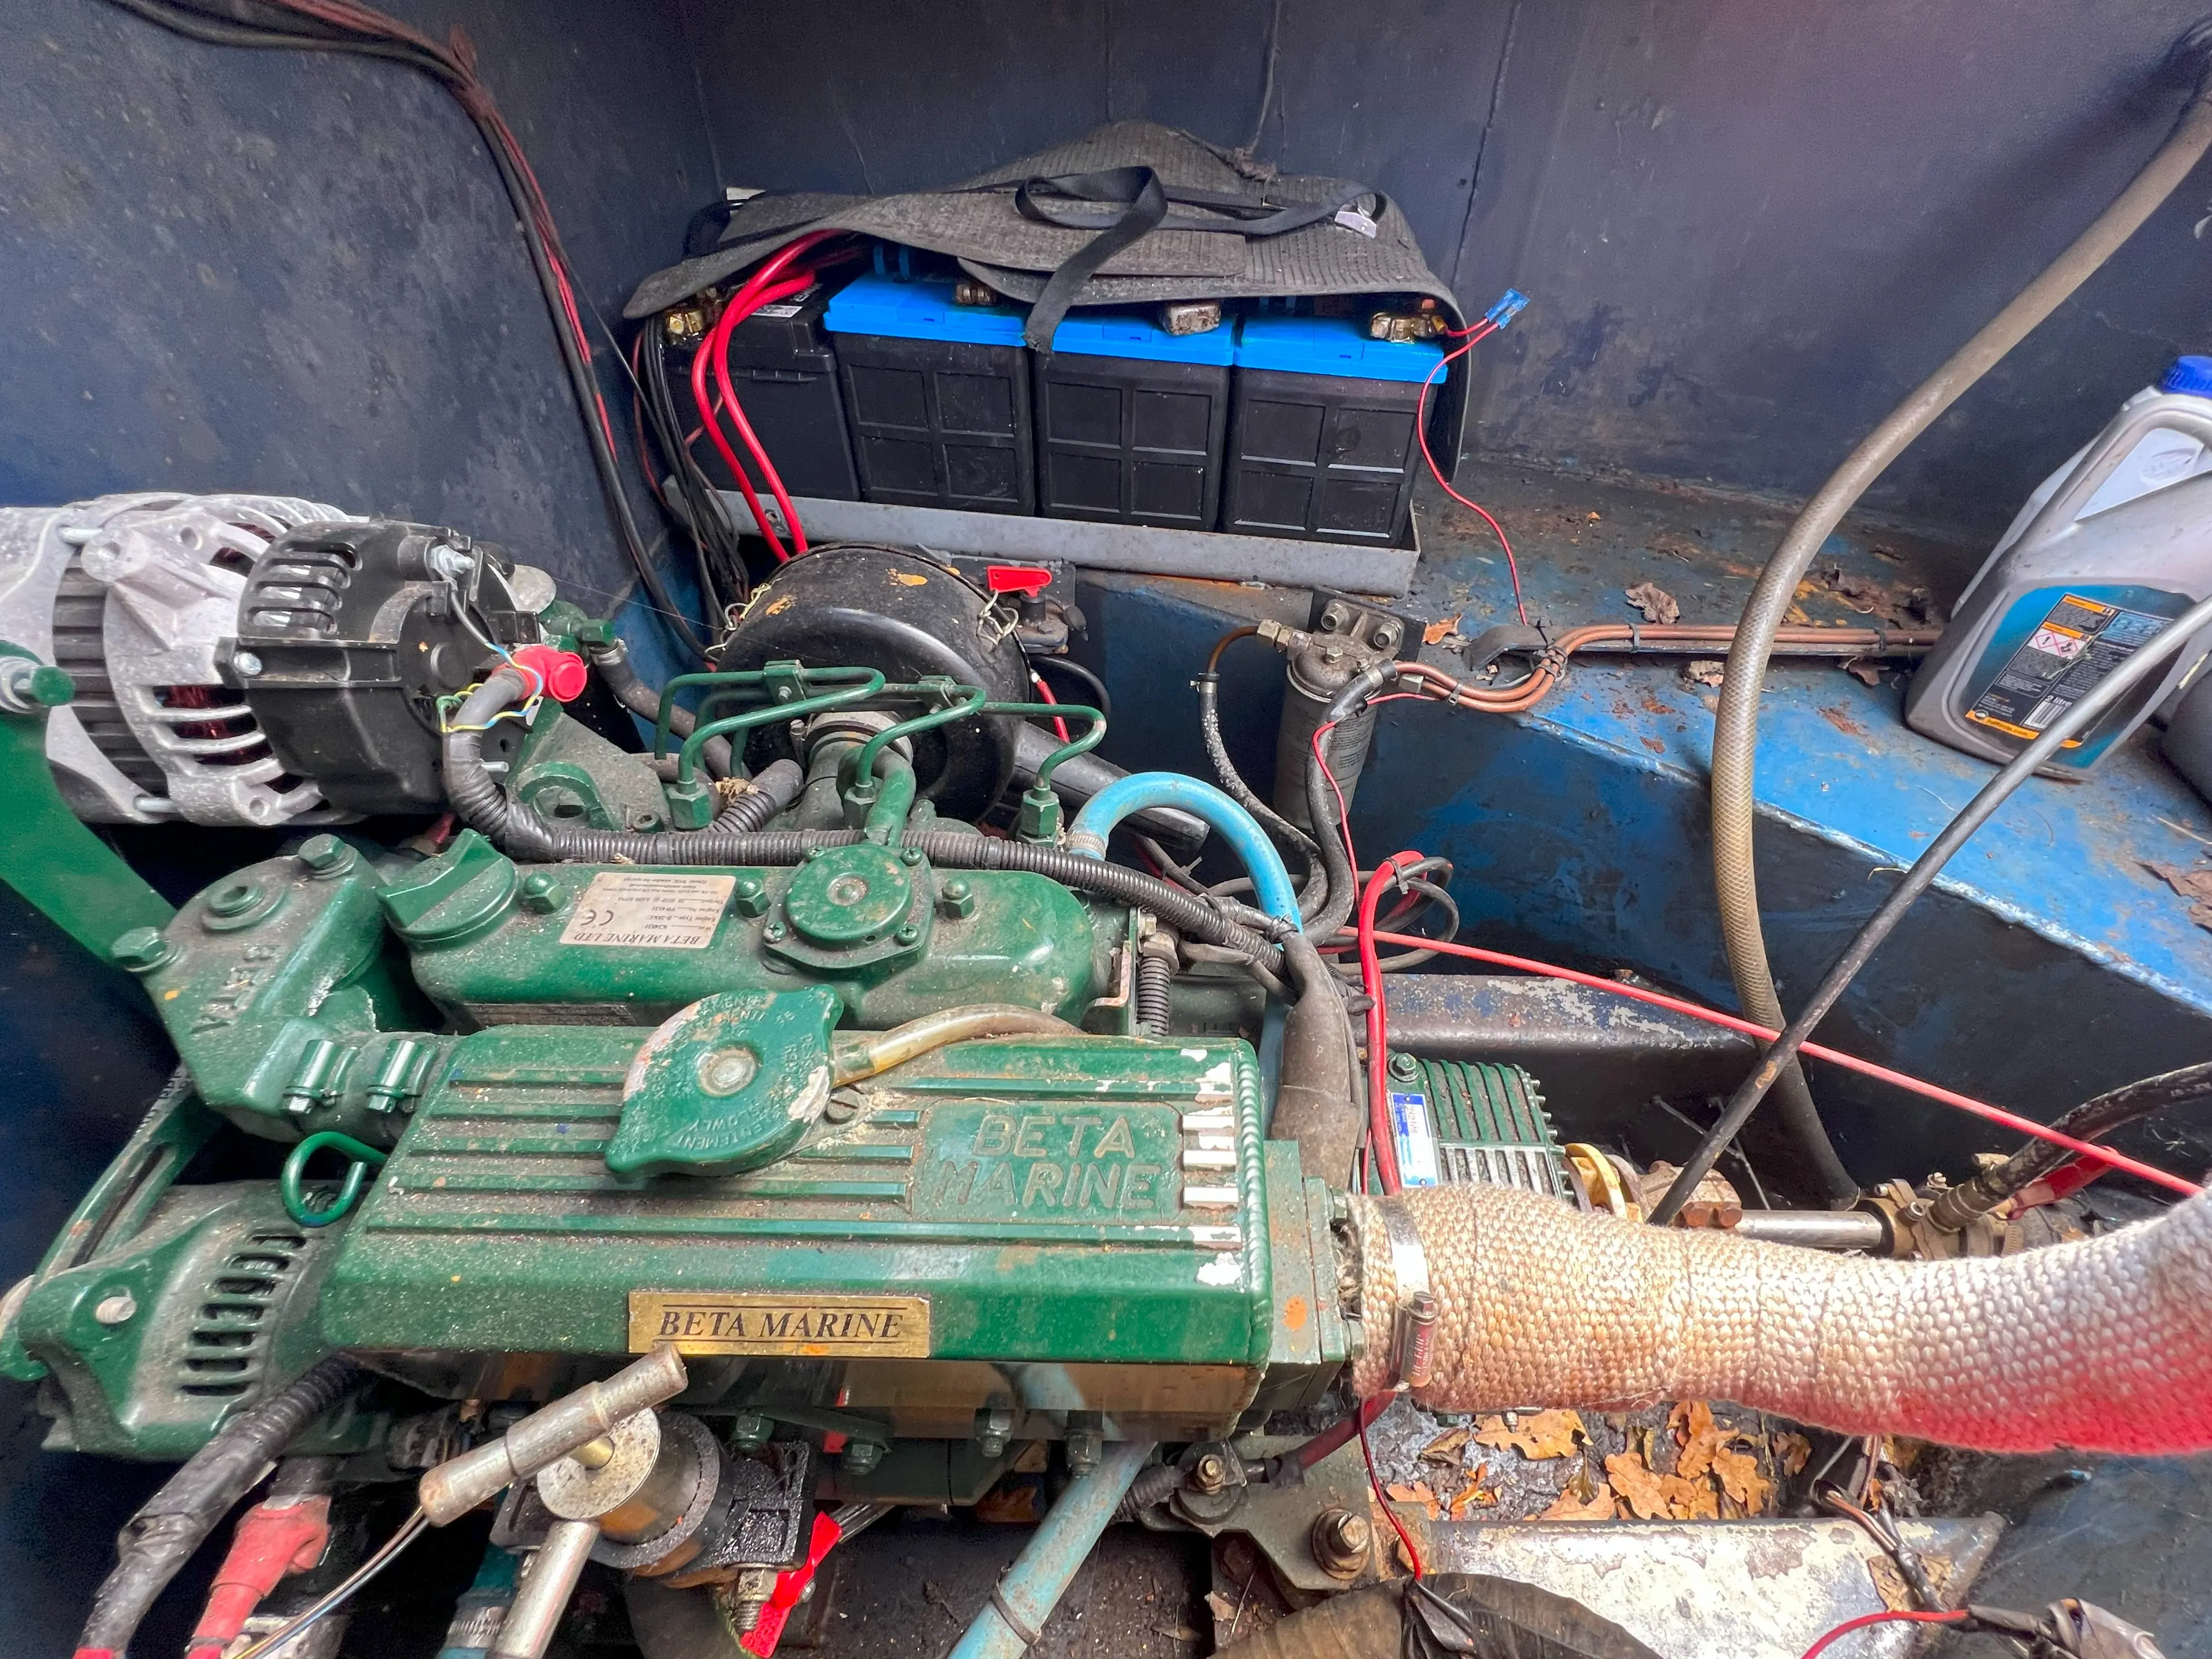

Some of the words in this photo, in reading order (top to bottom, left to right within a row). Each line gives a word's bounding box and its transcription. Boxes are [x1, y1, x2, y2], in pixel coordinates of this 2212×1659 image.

[573, 932, 602, 941] LTD
[604, 933, 661, 943] MARINE
[663, 935, 700, 944] BETA
[972, 1113, 1135, 1159] BETA
[935, 1160, 1162, 1210] MARINE
[658, 1311, 746, 1337] BETA
[757, 1312, 904, 1338] MARINE
